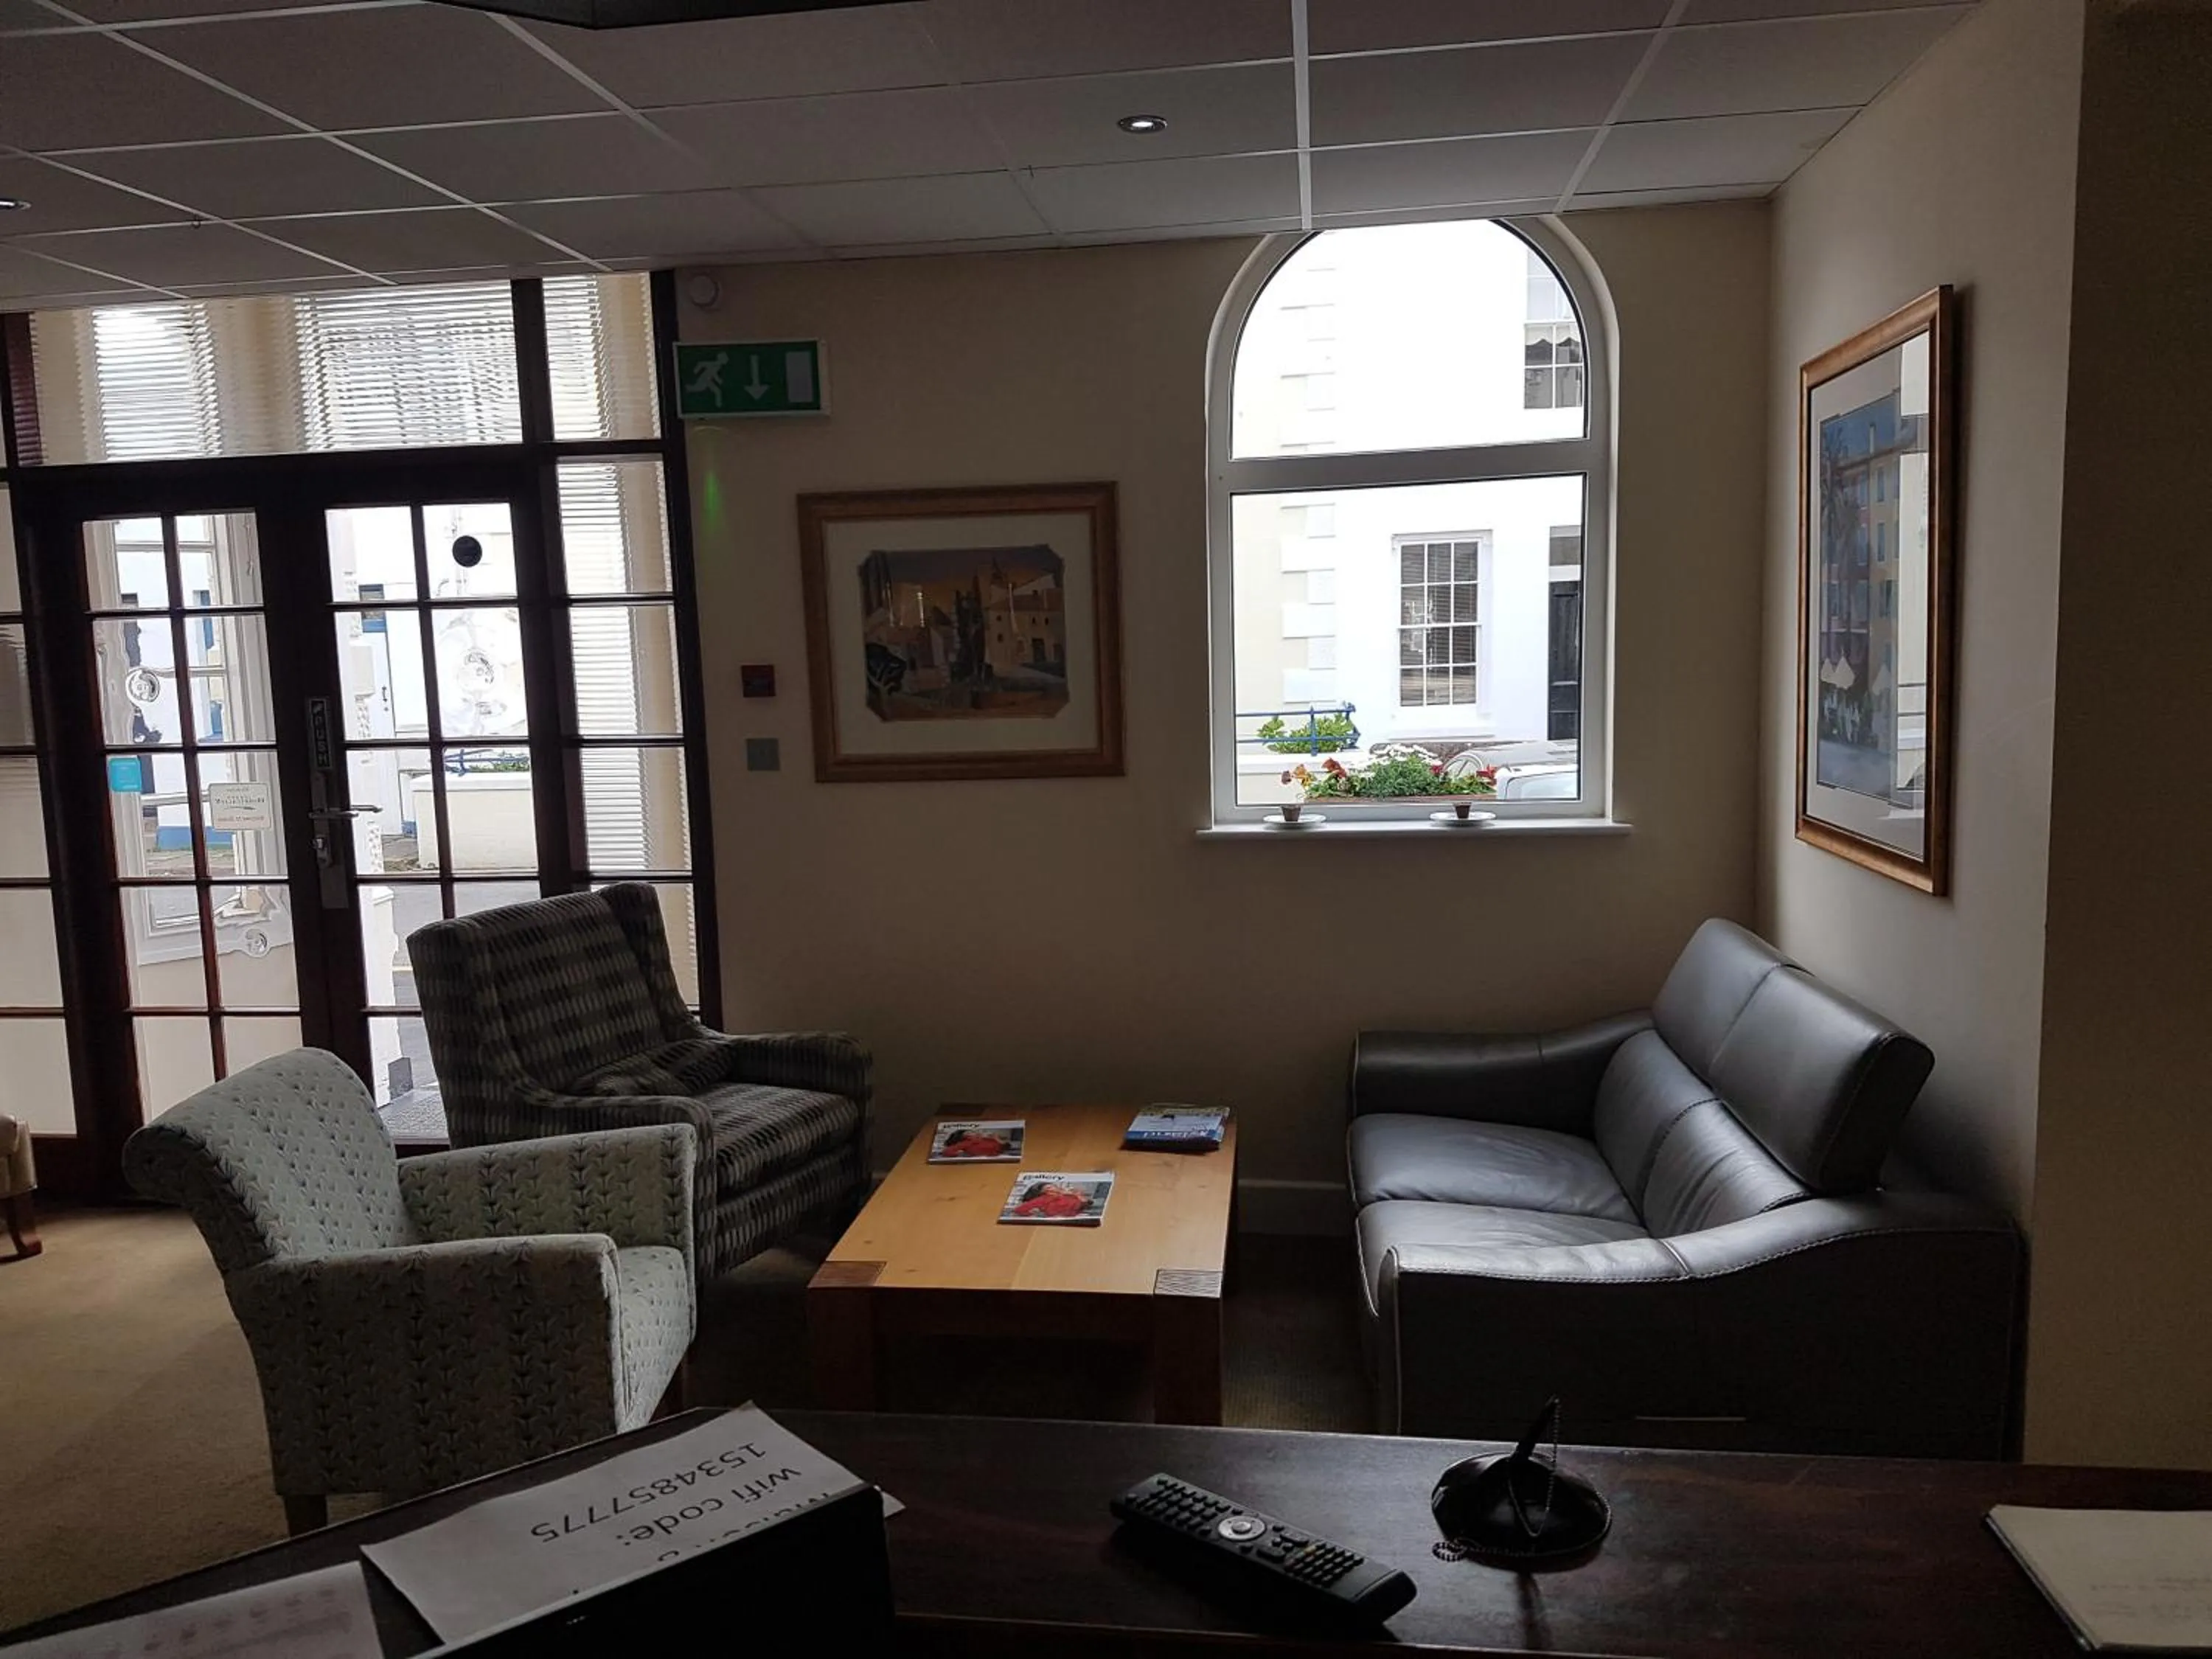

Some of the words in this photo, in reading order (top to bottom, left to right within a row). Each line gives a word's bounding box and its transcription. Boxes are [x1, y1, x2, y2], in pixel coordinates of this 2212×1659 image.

[1022, 1173, 1065, 1182] gallery
[530, 1441, 767, 1543] 1534857775
[731, 1467, 802, 1504] wifi
[616, 1498, 725, 1546] code:
